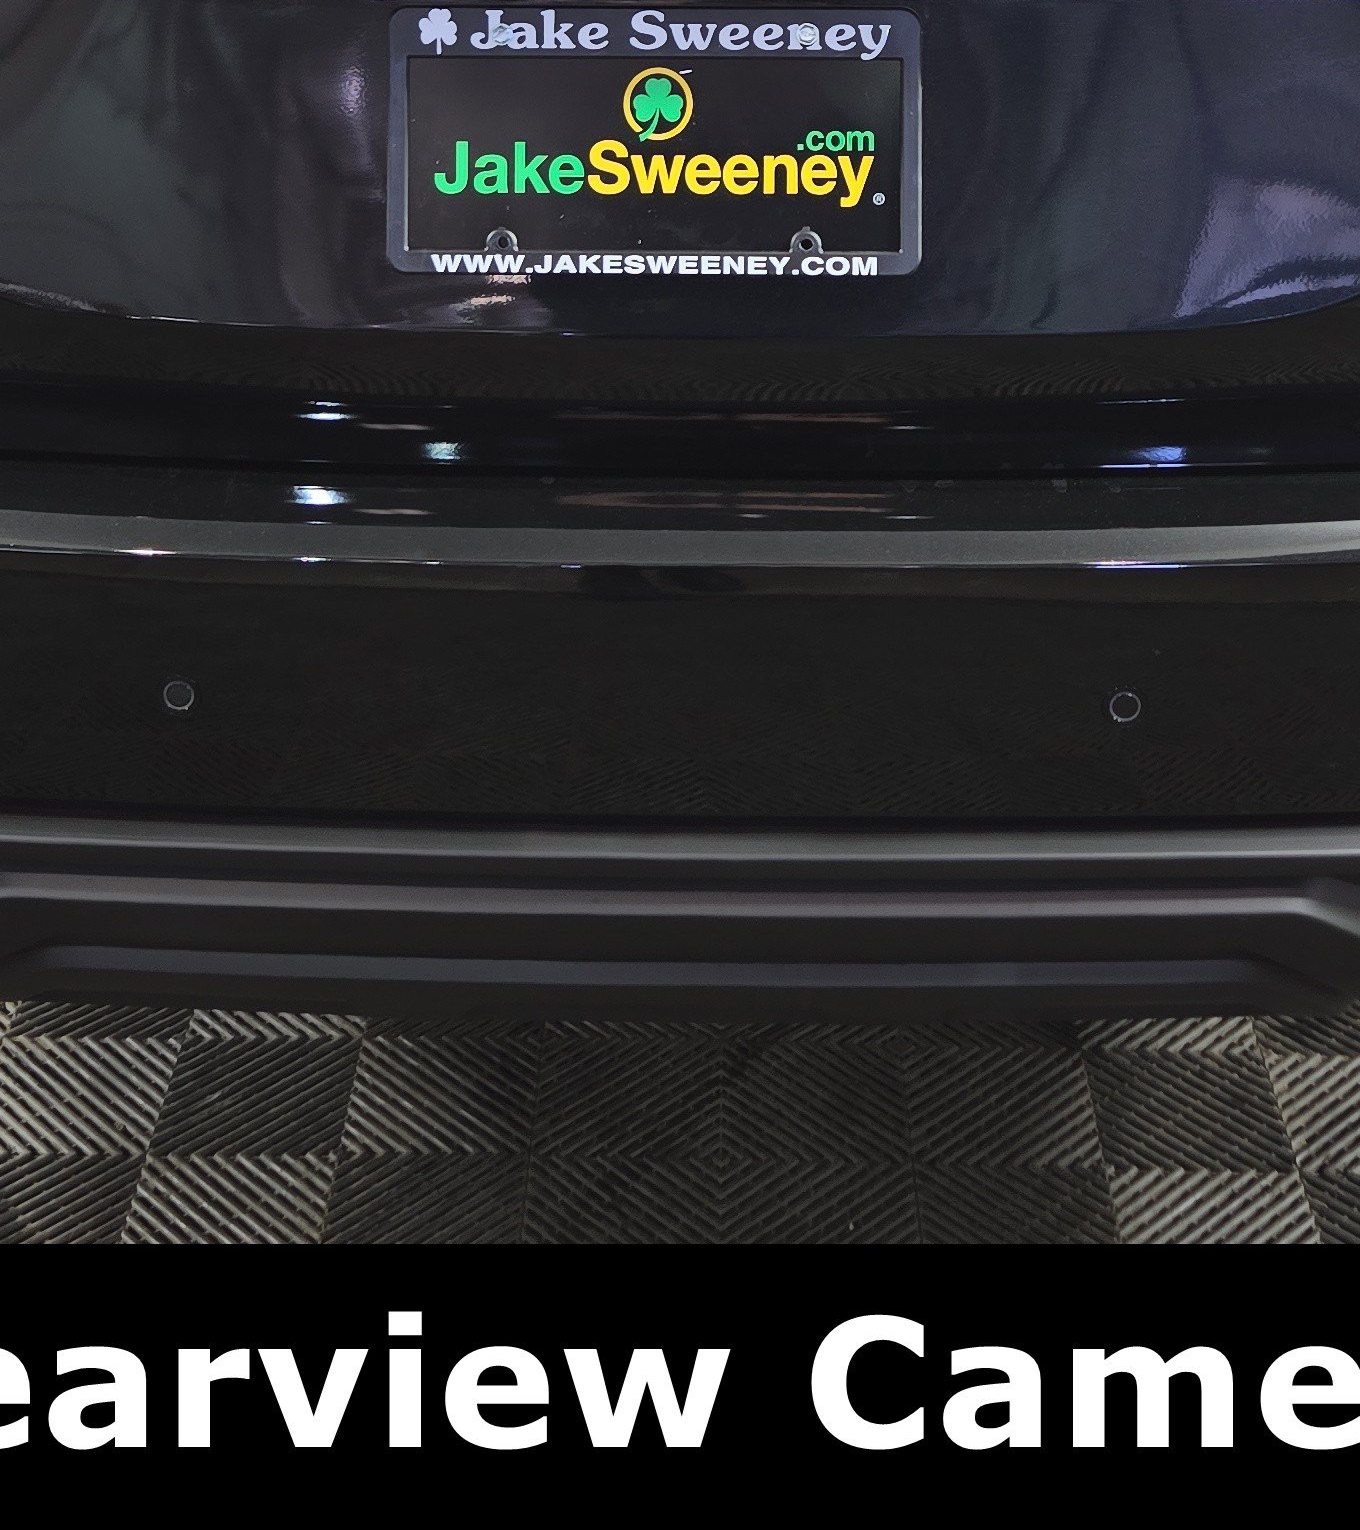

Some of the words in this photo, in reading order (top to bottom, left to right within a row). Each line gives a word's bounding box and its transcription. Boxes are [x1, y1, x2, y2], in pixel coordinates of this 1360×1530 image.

[470, 9, 610, 51] Jake
[629, 10, 891, 61] Sweeney
[430, 253, 879, 277] WWW.JAKESWEENEY.COM
